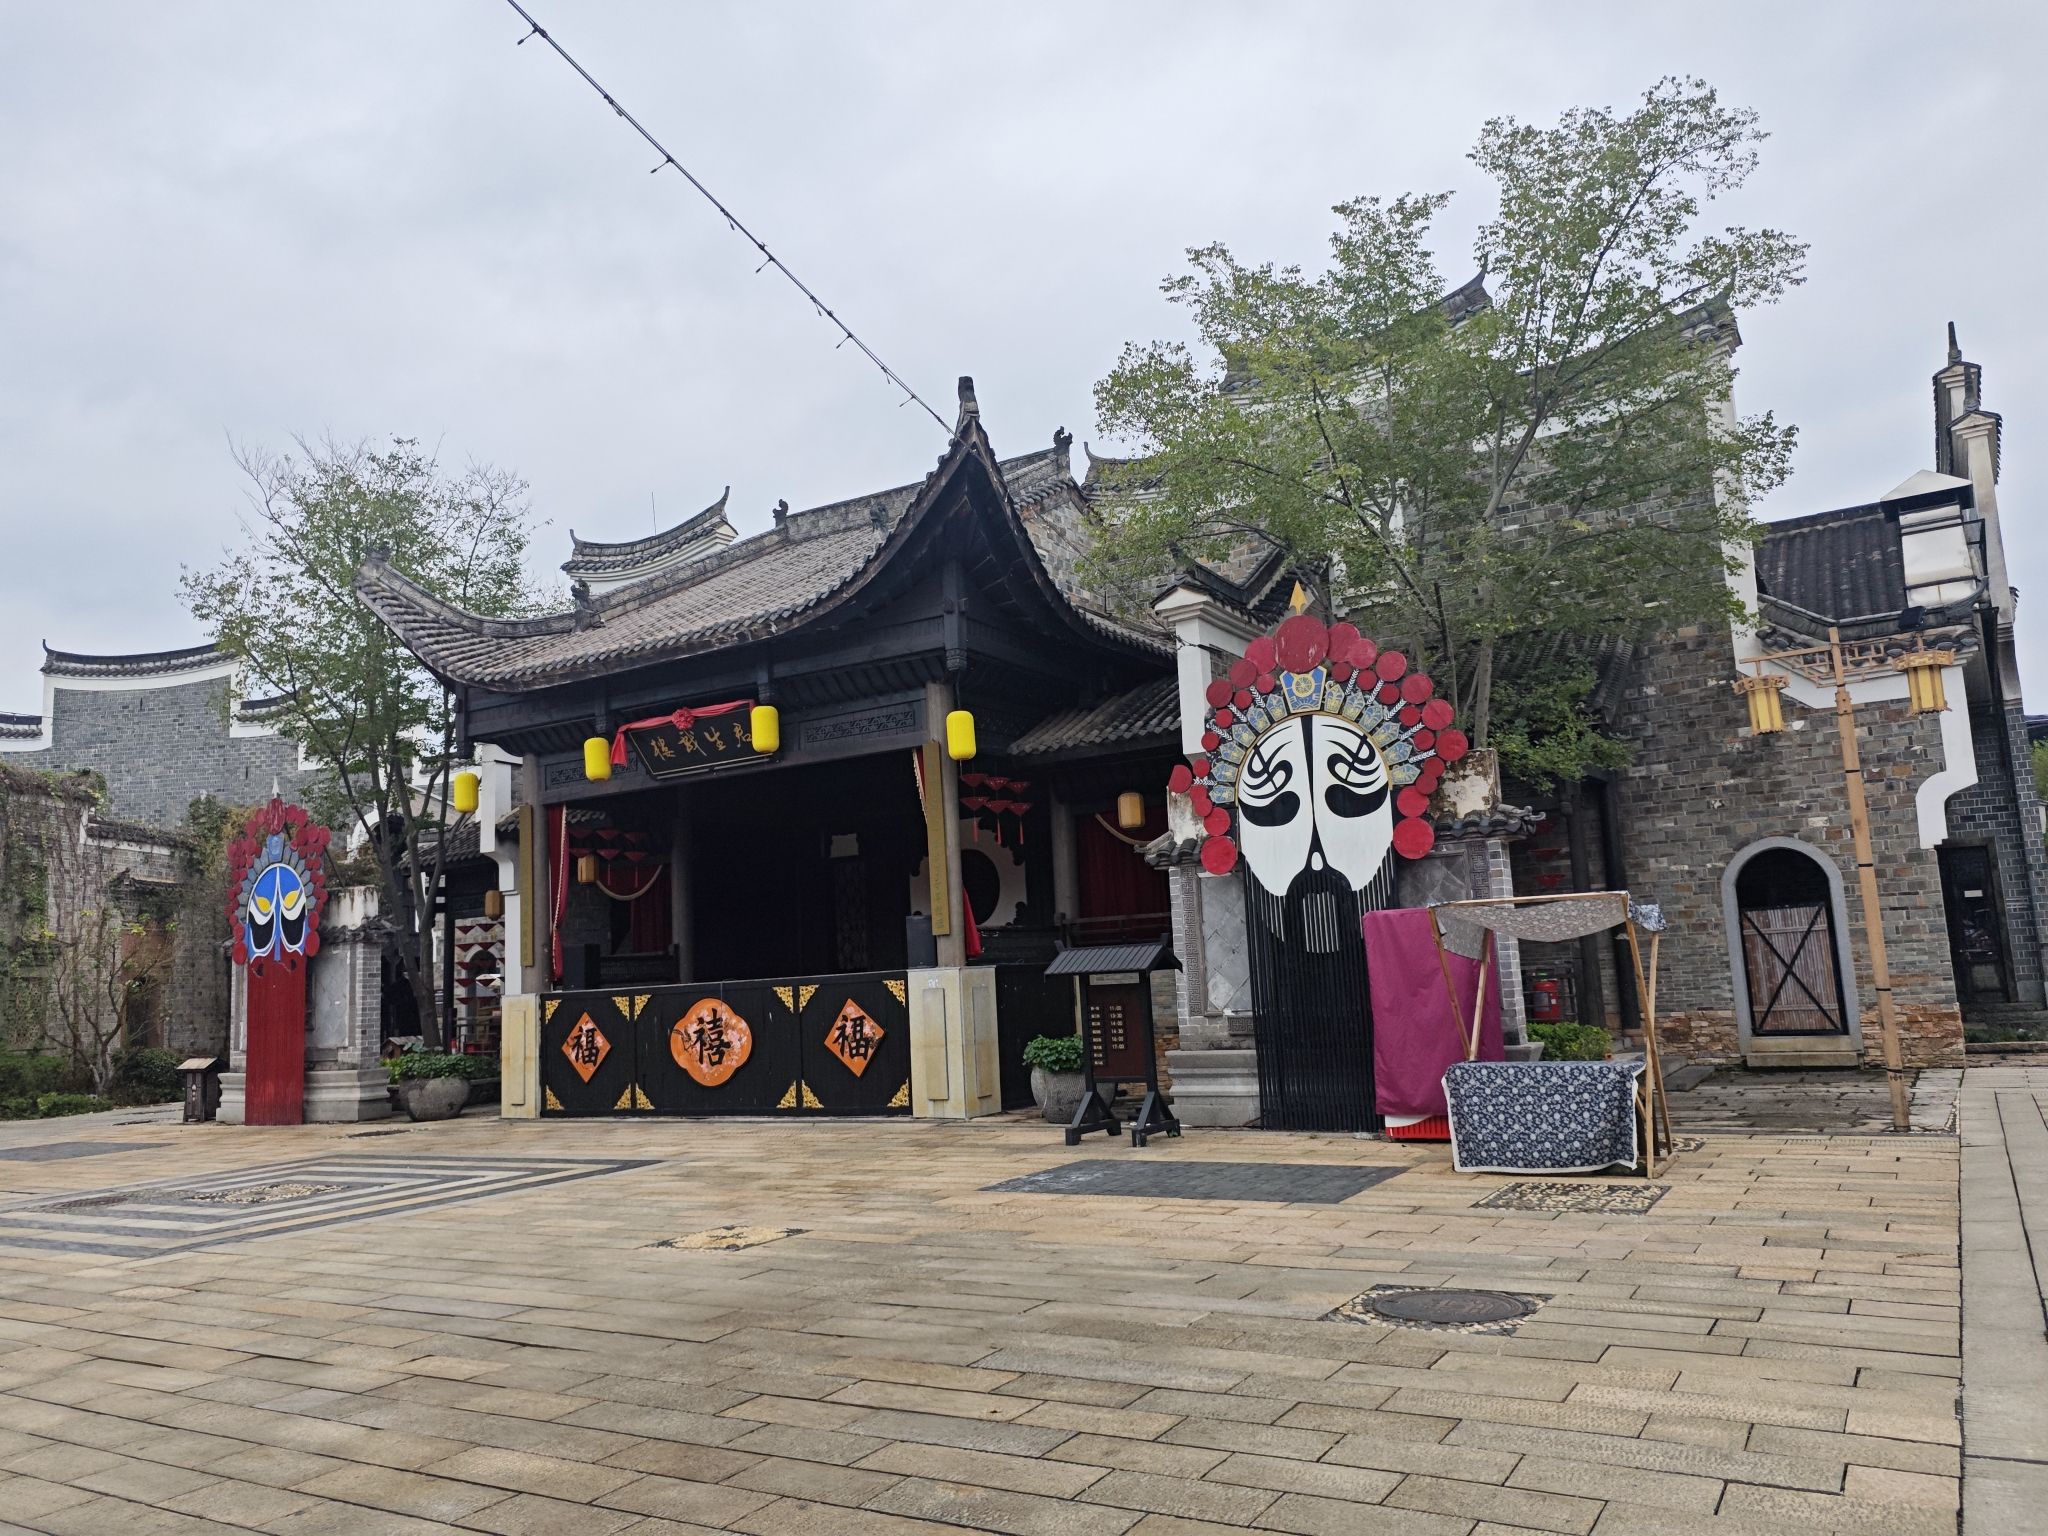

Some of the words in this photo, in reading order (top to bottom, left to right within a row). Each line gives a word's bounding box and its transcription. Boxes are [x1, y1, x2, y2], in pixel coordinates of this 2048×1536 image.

[571, 1025, 600, 1068] 福
[692, 1007, 732, 1067] 禧
[832, 1014, 871, 1061] 福
